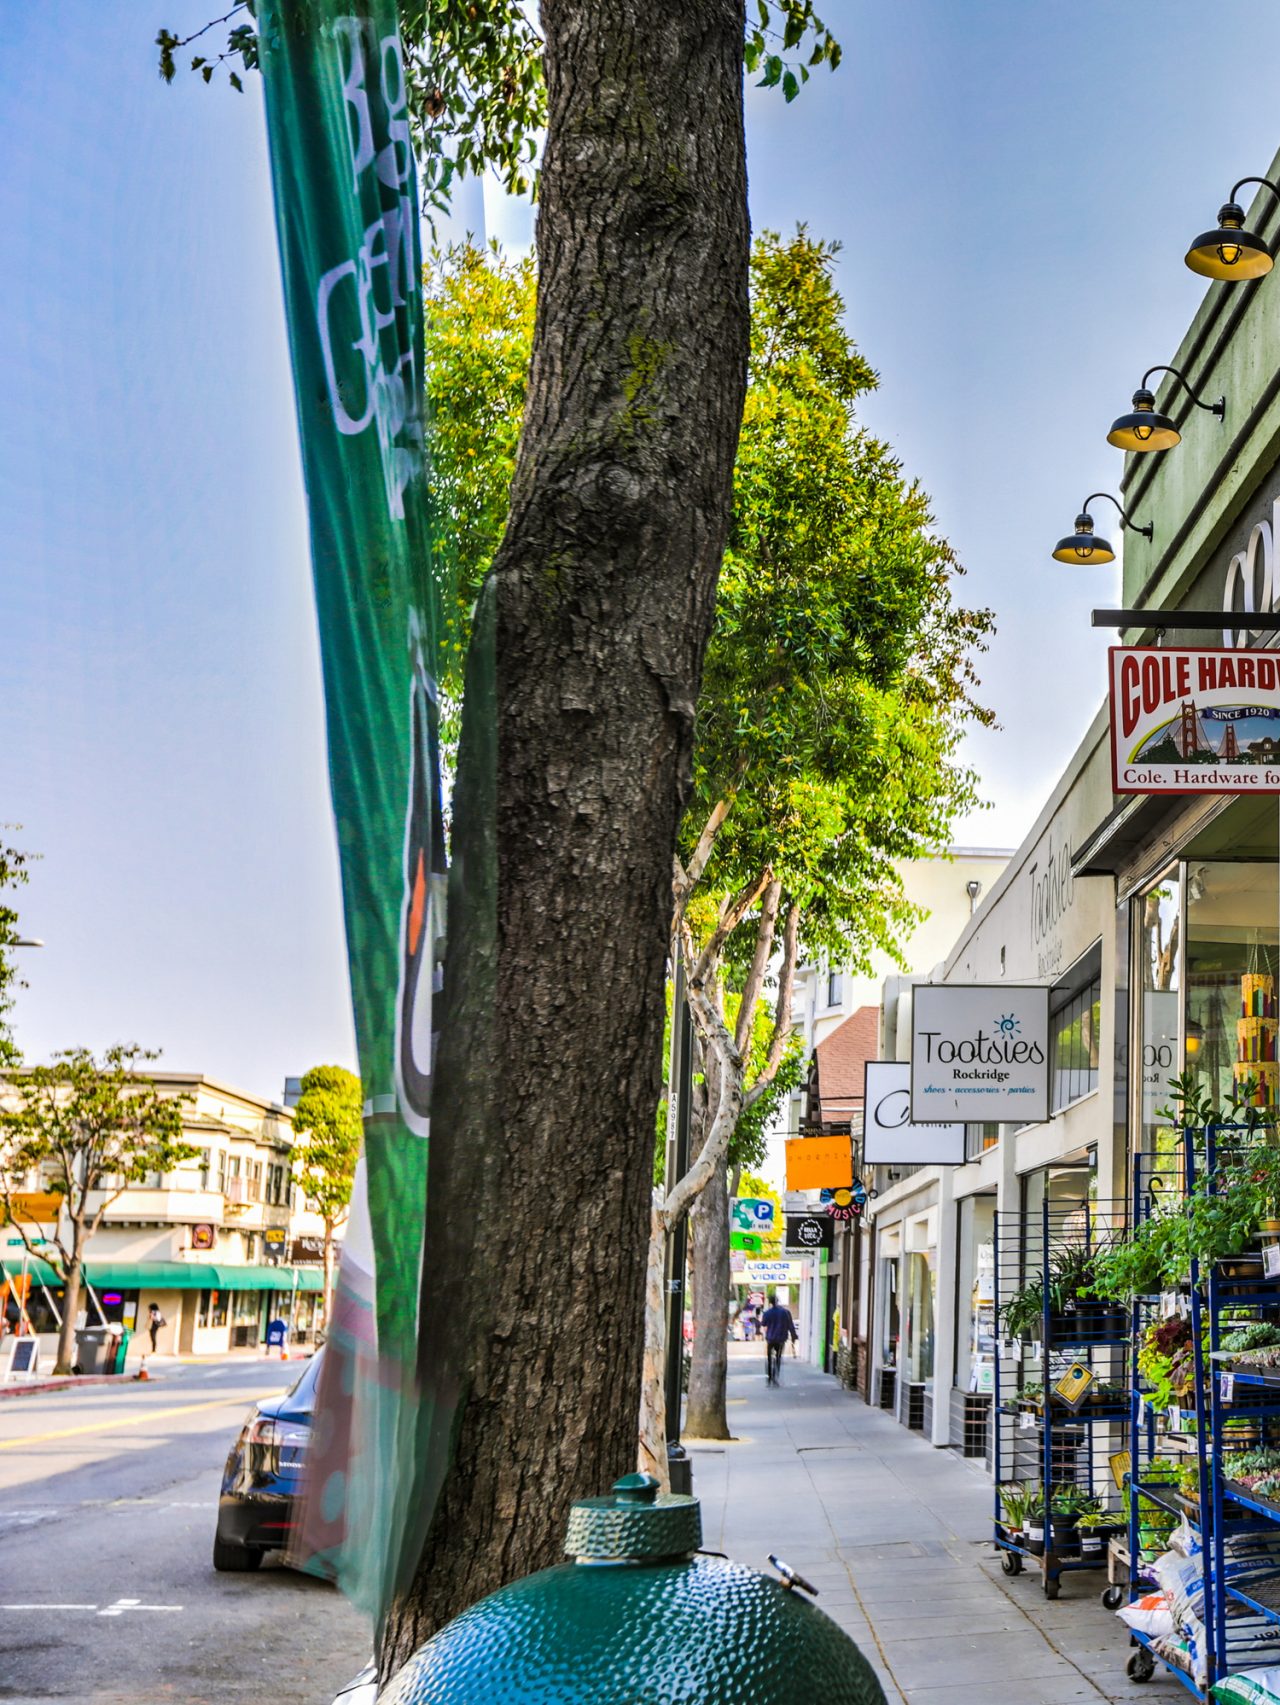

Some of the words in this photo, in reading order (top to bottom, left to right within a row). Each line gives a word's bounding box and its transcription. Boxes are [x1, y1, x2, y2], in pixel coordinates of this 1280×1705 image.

[1121, 655, 1191, 739] COLE
[1212, 709, 1241, 720] SINCE
[1245, 706, 1270, 717] 1920
[1123, 768, 1167, 785] Cole.
[1174, 769, 1259, 785] Hardware
[917, 1029, 1045, 1064] Tootsies
[952, 1068, 1010, 1083] Rockridge
[923, 1083, 946, 1095] shoes
[954, 1085, 1000, 1095] accessories
[1007, 1084, 1036, 1096] parties
[670, 1094, 678, 1138] A5987
[825, 1203, 861, 1220] MUSIC
[751, 1273, 787, 1281] VIDEO
